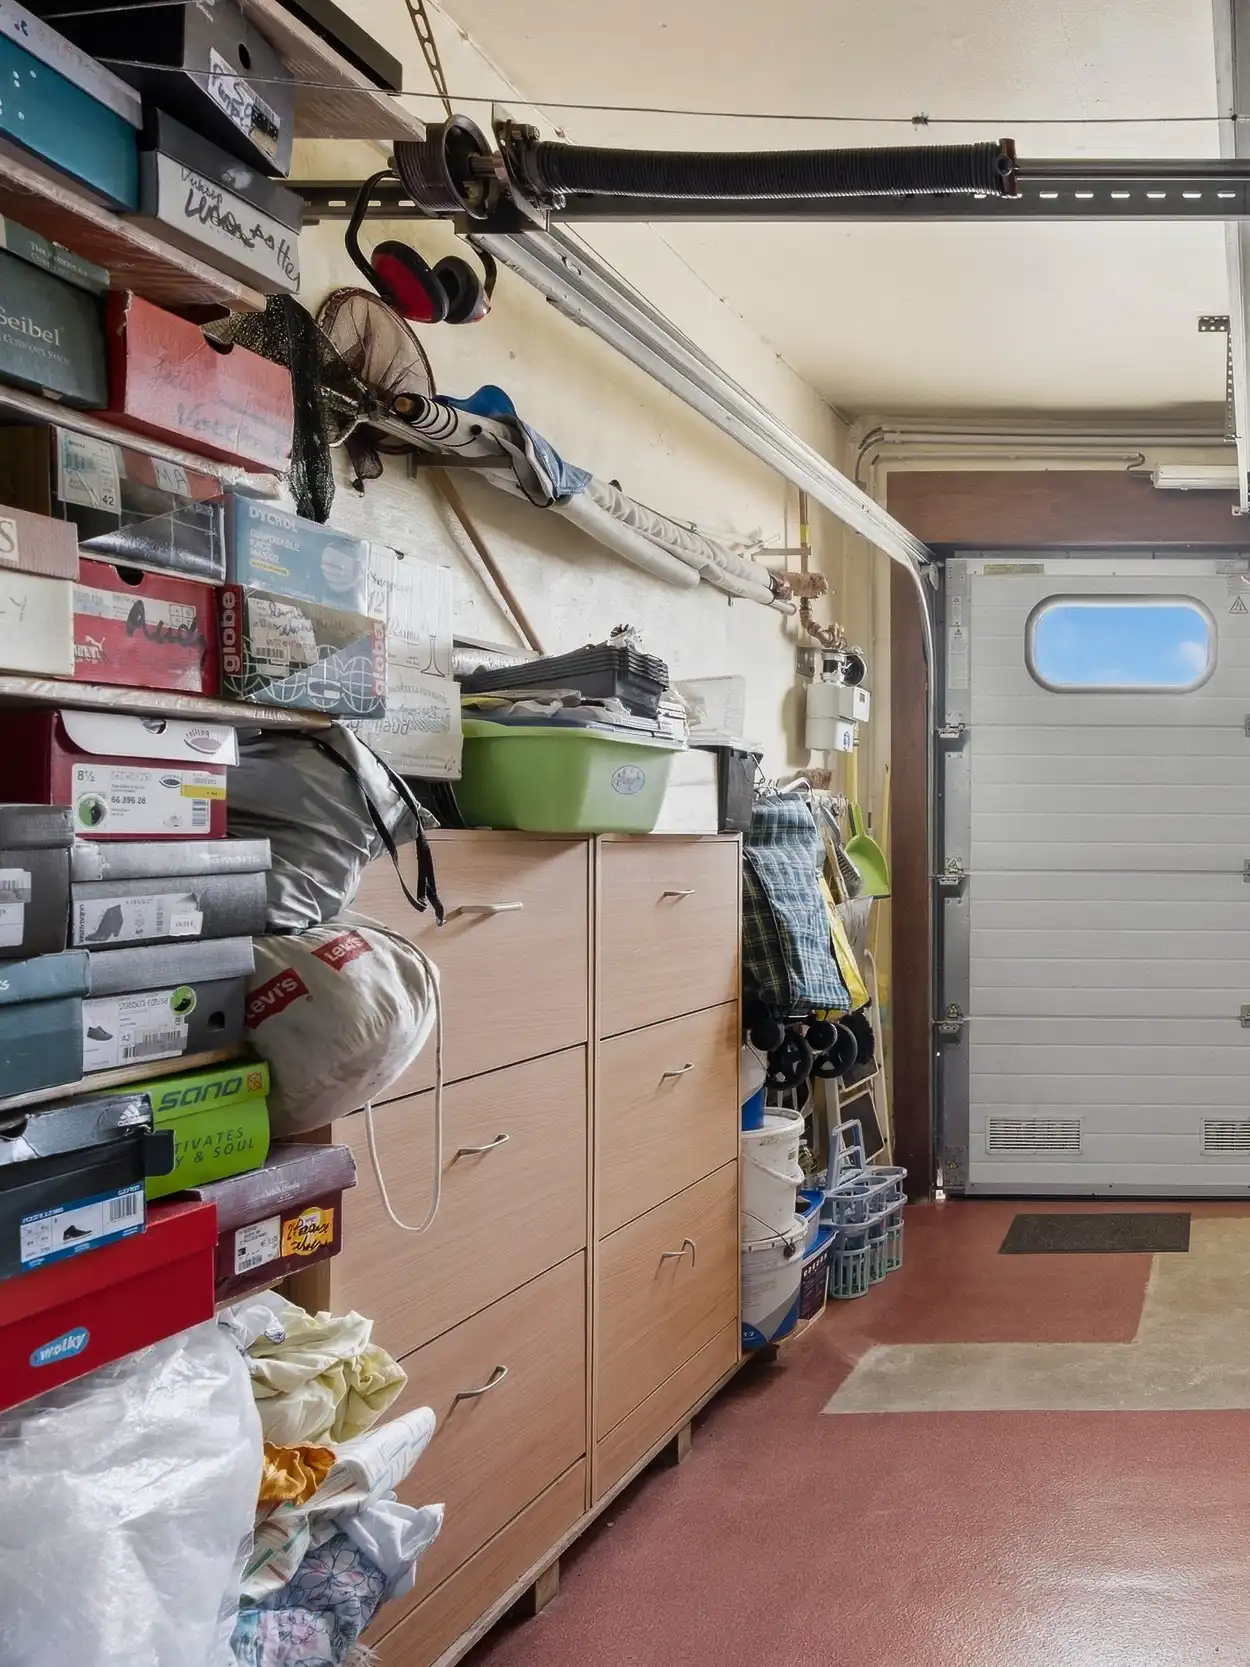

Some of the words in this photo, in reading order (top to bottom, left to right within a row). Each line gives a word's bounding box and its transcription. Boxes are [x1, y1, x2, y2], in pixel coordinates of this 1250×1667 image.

[222, 591, 240, 672] globe
[175, 1126, 244, 1153] TIVATES
[193, 1151, 204, 1164] &
[213, 1138, 254, 1158] SOUL
[39, 1332, 87, 1362] wolky
